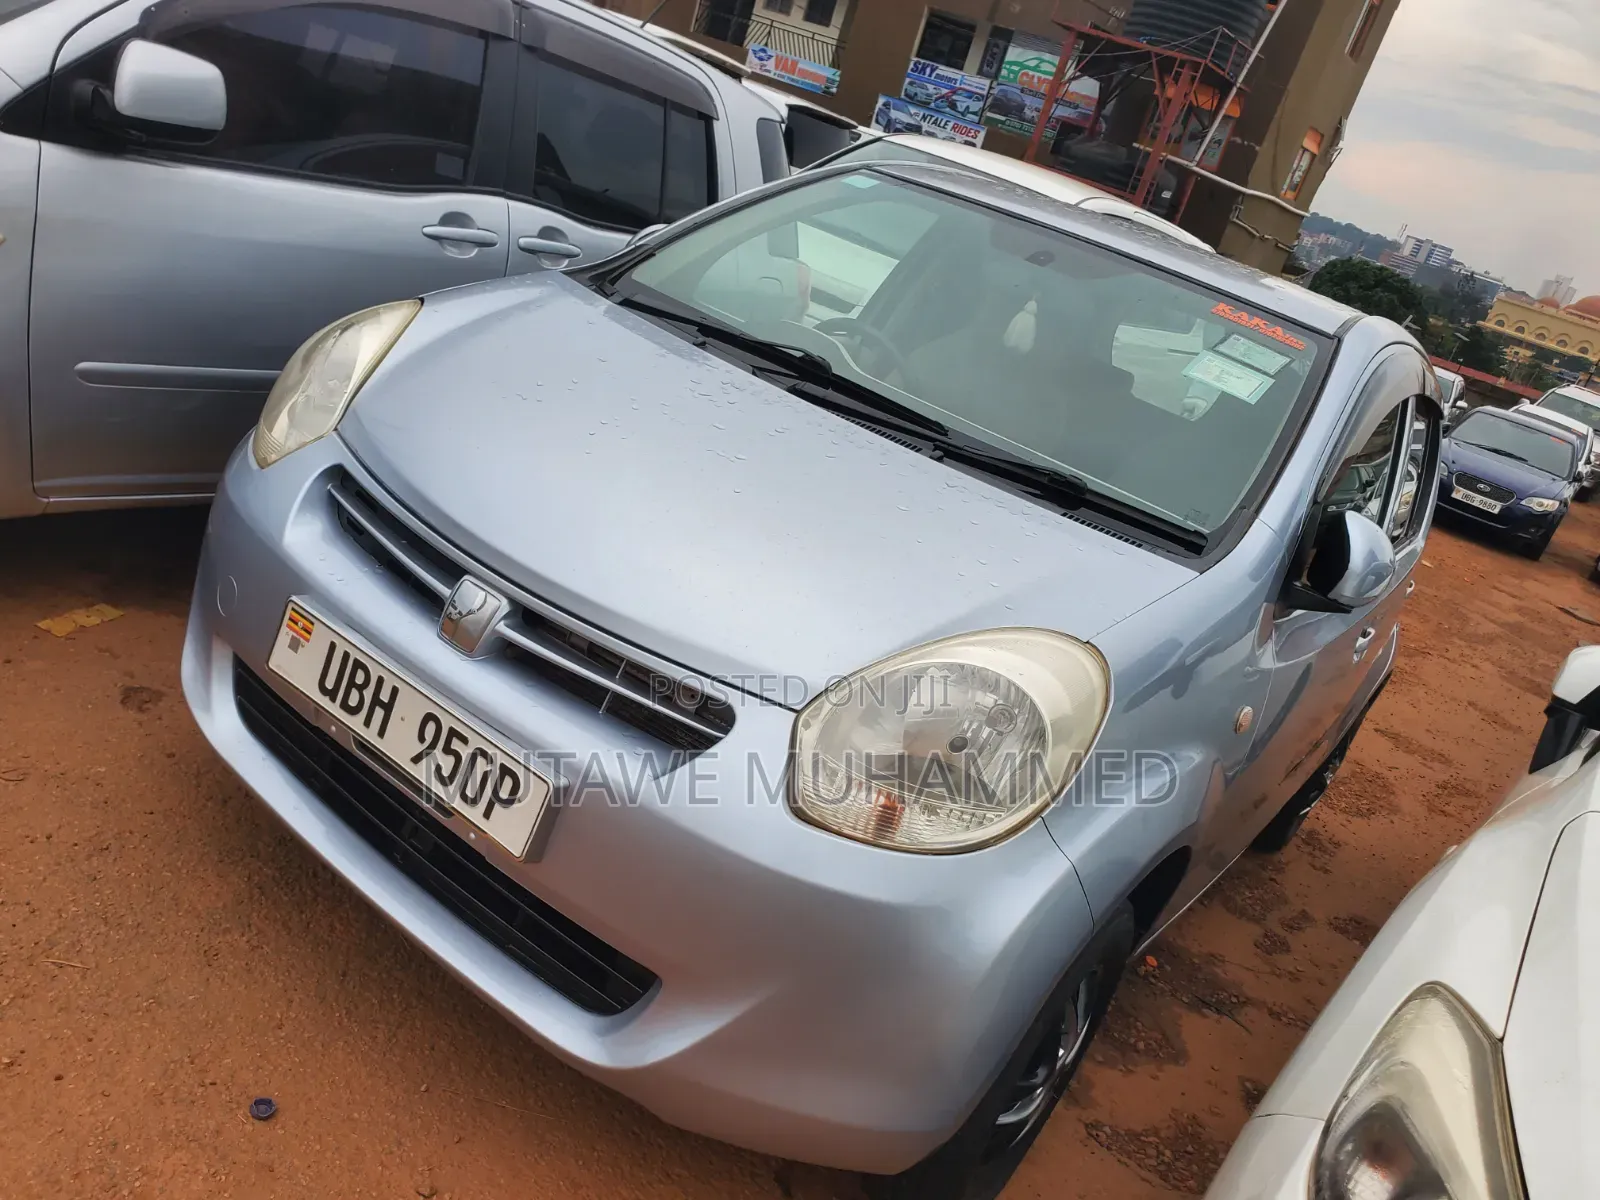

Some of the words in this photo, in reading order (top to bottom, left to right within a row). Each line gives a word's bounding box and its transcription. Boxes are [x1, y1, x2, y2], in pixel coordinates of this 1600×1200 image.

[910, 59, 939, 78] SKY
[919, 111, 951, 130] NTALE
[950, 122, 981, 140] RIDES
[1460, 492, 1477, 504] UBG
[317, 640, 400, 740] UBH
